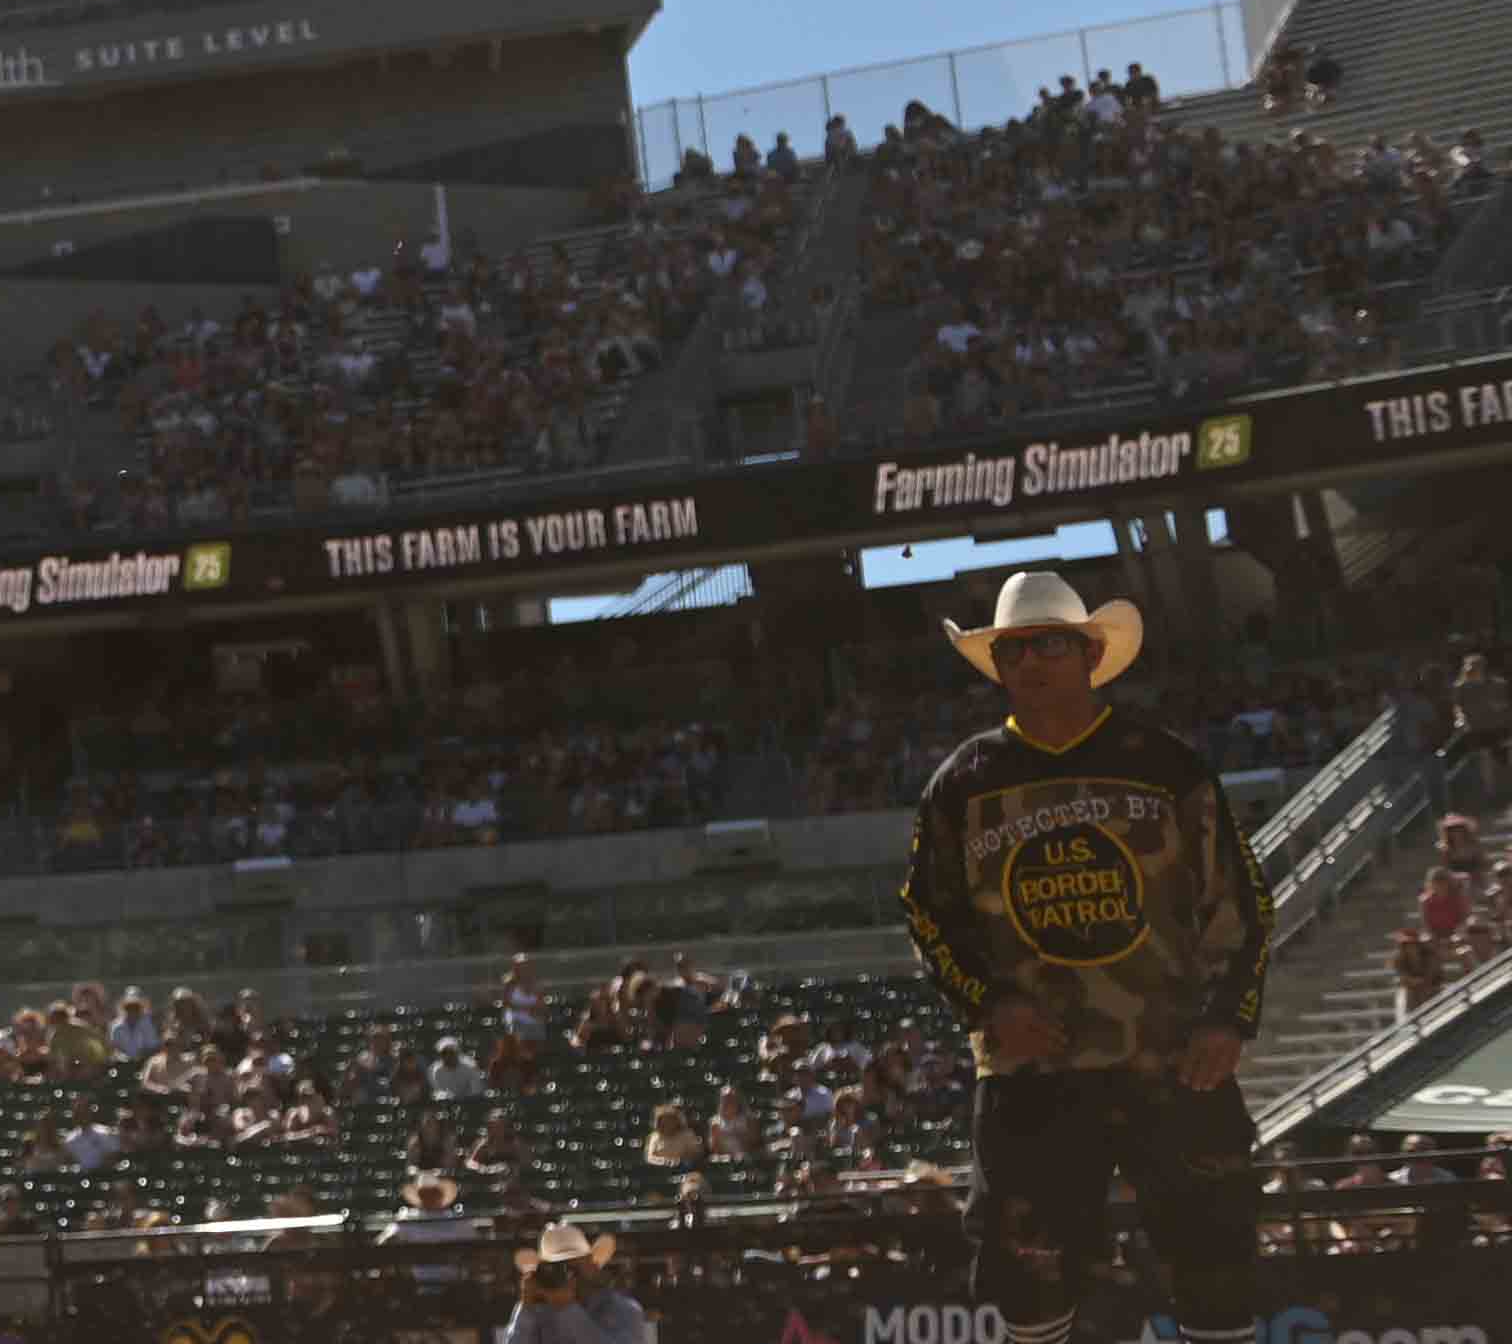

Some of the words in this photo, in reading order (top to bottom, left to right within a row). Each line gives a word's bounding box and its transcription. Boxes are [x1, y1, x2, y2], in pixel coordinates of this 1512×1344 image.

[74, 34, 184, 71] SUITE
[202, 17, 320, 56] LEVEL
[1363, 391, 1453, 442] THIS
[875, 452, 1016, 513] Farming
[1021, 430, 1192, 497] Simulator
[1206, 422, 1244, 462] 25
[324, 534, 394, 577] THIS
[399, 524, 481, 570] FARM
[486, 519, 520, 561] IS
[524, 508, 607, 556] YOUR
[612, 496, 699, 544] FARM
[36, 552, 181, 605] Simulator
[194, 553, 222, 583] 25
[1046, 837, 1098, 865] U.S.
[1031, 895, 1138, 929] PATROL
